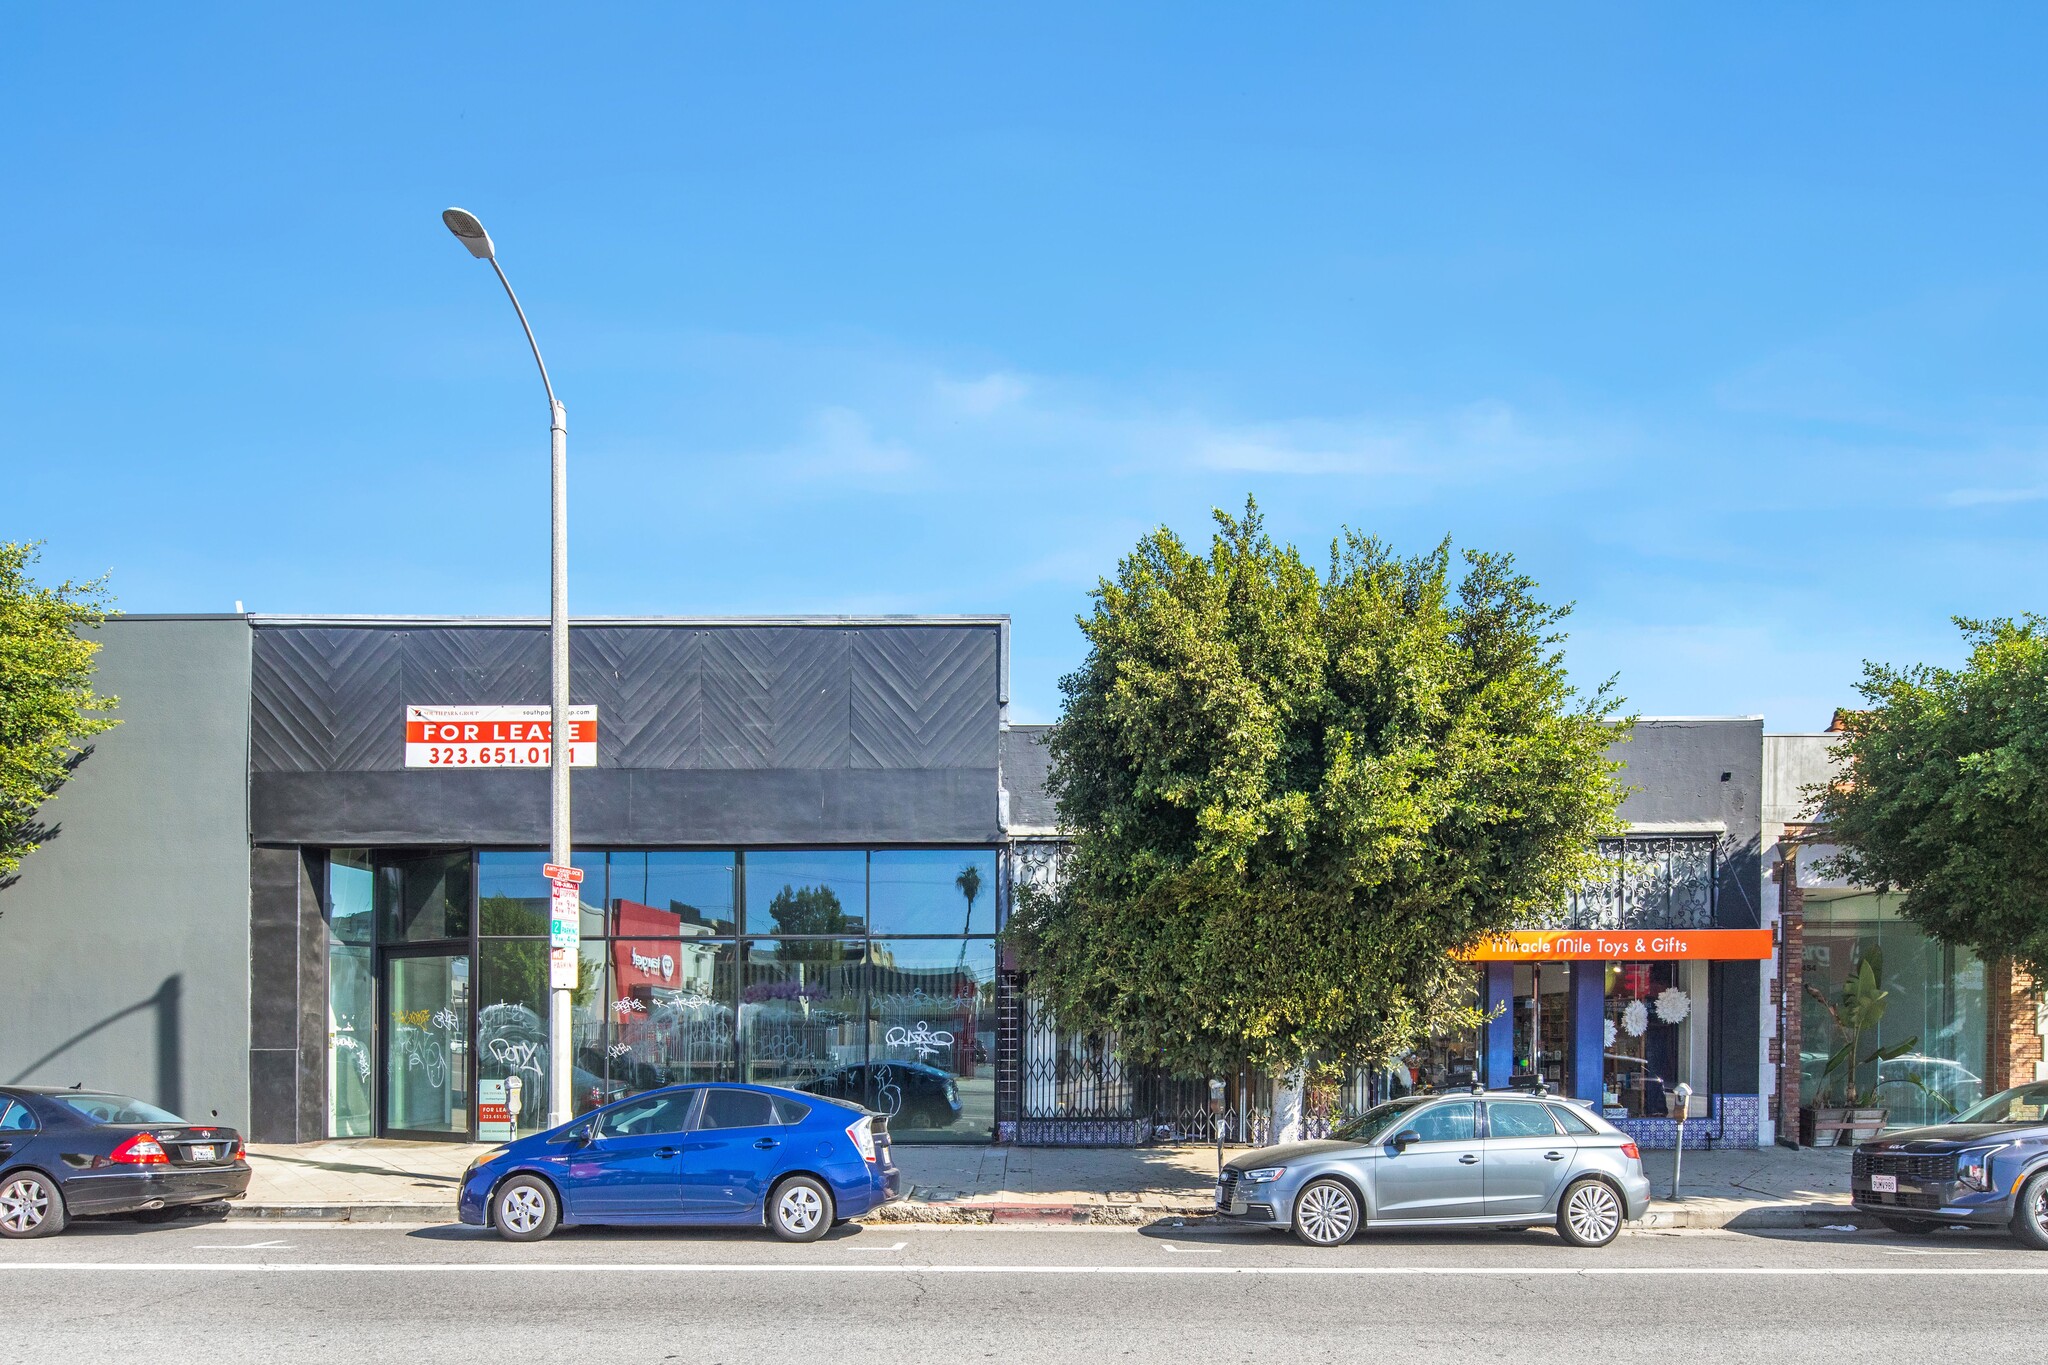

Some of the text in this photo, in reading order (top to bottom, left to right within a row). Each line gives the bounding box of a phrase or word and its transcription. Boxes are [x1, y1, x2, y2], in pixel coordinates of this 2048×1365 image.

[423, 724, 580, 741] FOR LEAE
[429, 747, 574, 764] 323.651.011
[554, 921, 560, 933] 2
[1556, 937, 1591, 953] Mile
[1596, 938, 1629, 957] Toys
[1634, 938, 1647, 953] &
[1651, 936, 1687, 953] Gifts
